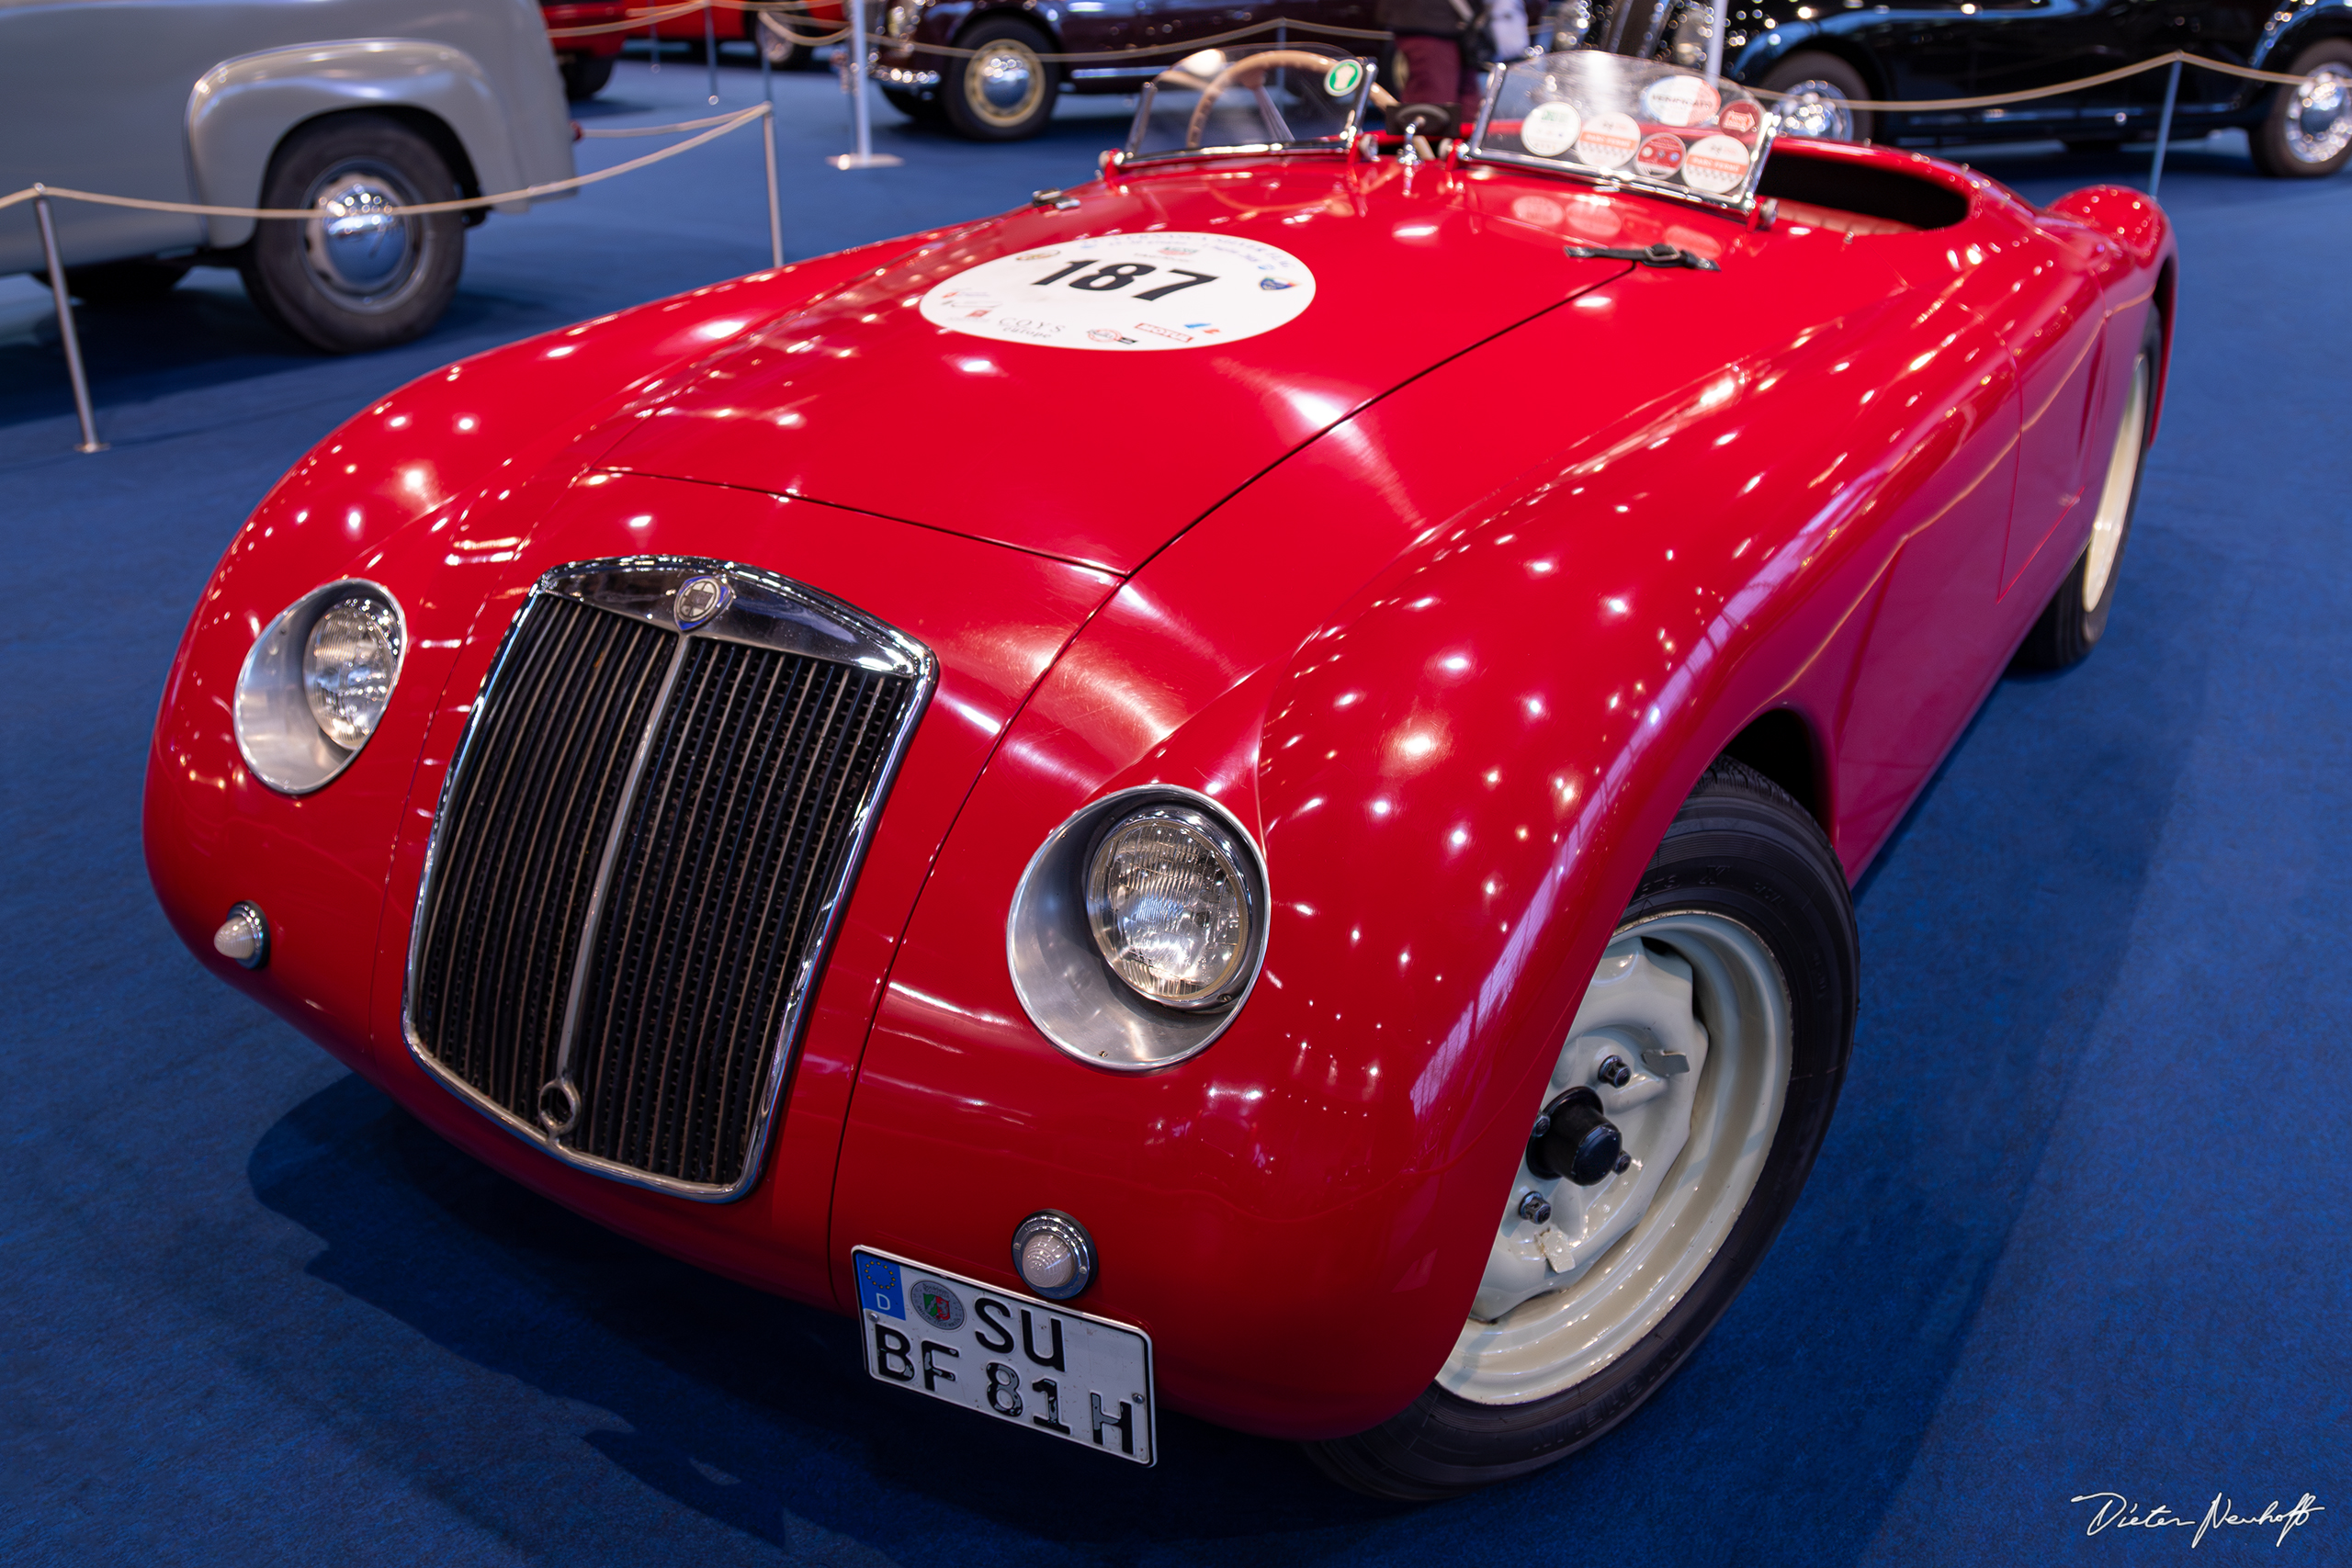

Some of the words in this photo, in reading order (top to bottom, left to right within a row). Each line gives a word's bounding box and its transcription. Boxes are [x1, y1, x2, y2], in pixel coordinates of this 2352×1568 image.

[1031, 259, 1220, 302] 187
[999, 316, 1066, 333] COYS
[1002, 326, 1053, 339] europe
[1136, 323, 1191, 342] MOTUL
[876, 1292, 891, 1312] D
[973, 1296, 1067, 1373] SU
[874, 1322, 961, 1393] BF
